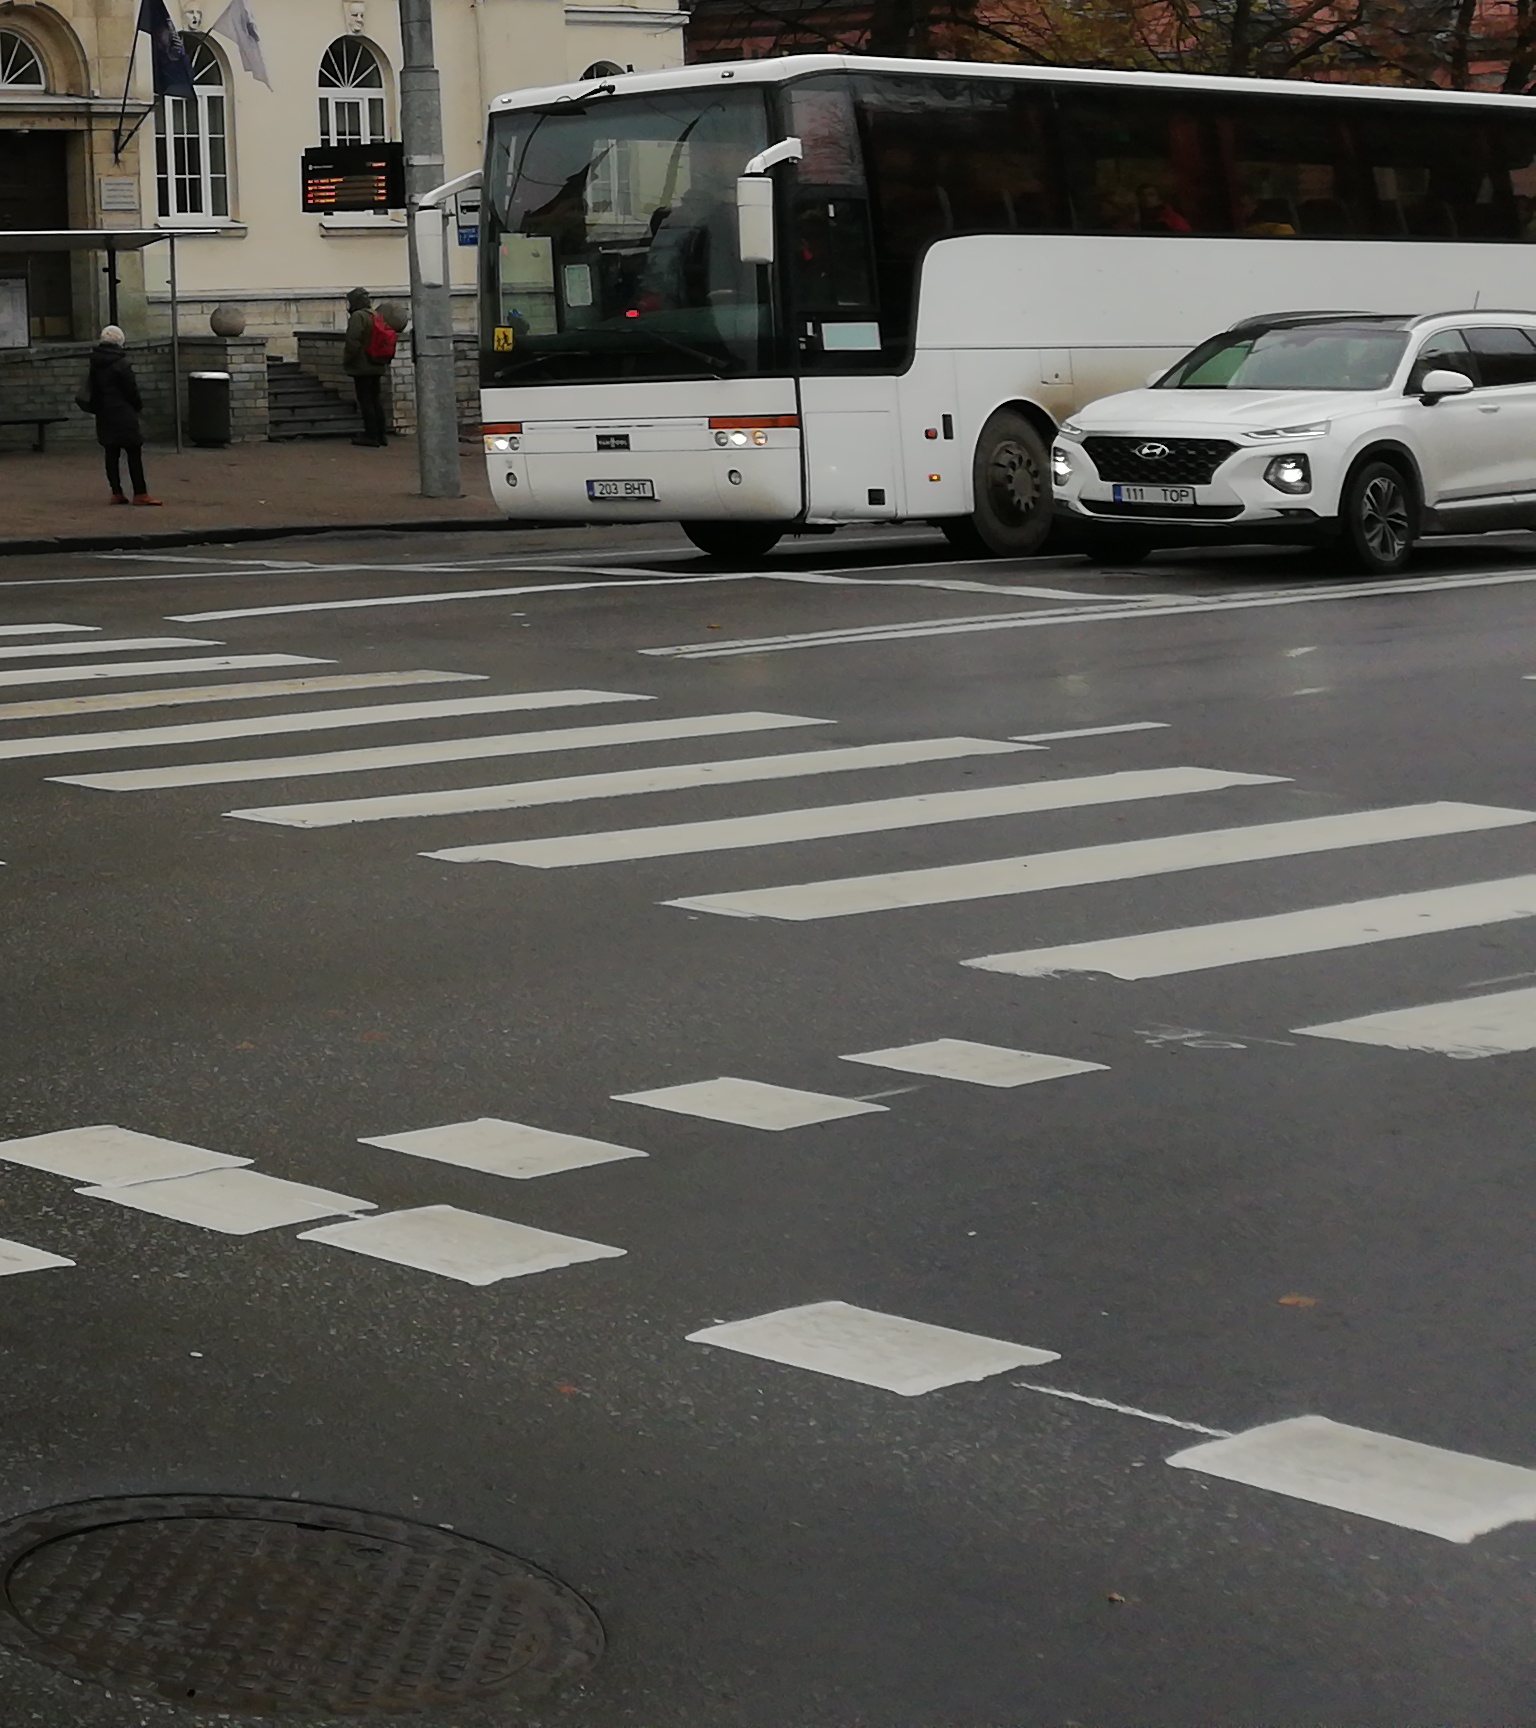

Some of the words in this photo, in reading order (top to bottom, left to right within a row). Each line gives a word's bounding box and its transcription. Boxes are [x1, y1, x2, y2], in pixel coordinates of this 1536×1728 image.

[598, 482, 619, 495] 203
[624, 482, 647, 495] BHT
[1126, 487, 1145, 500] 111
[1161, 488, 1190, 502] TOP
